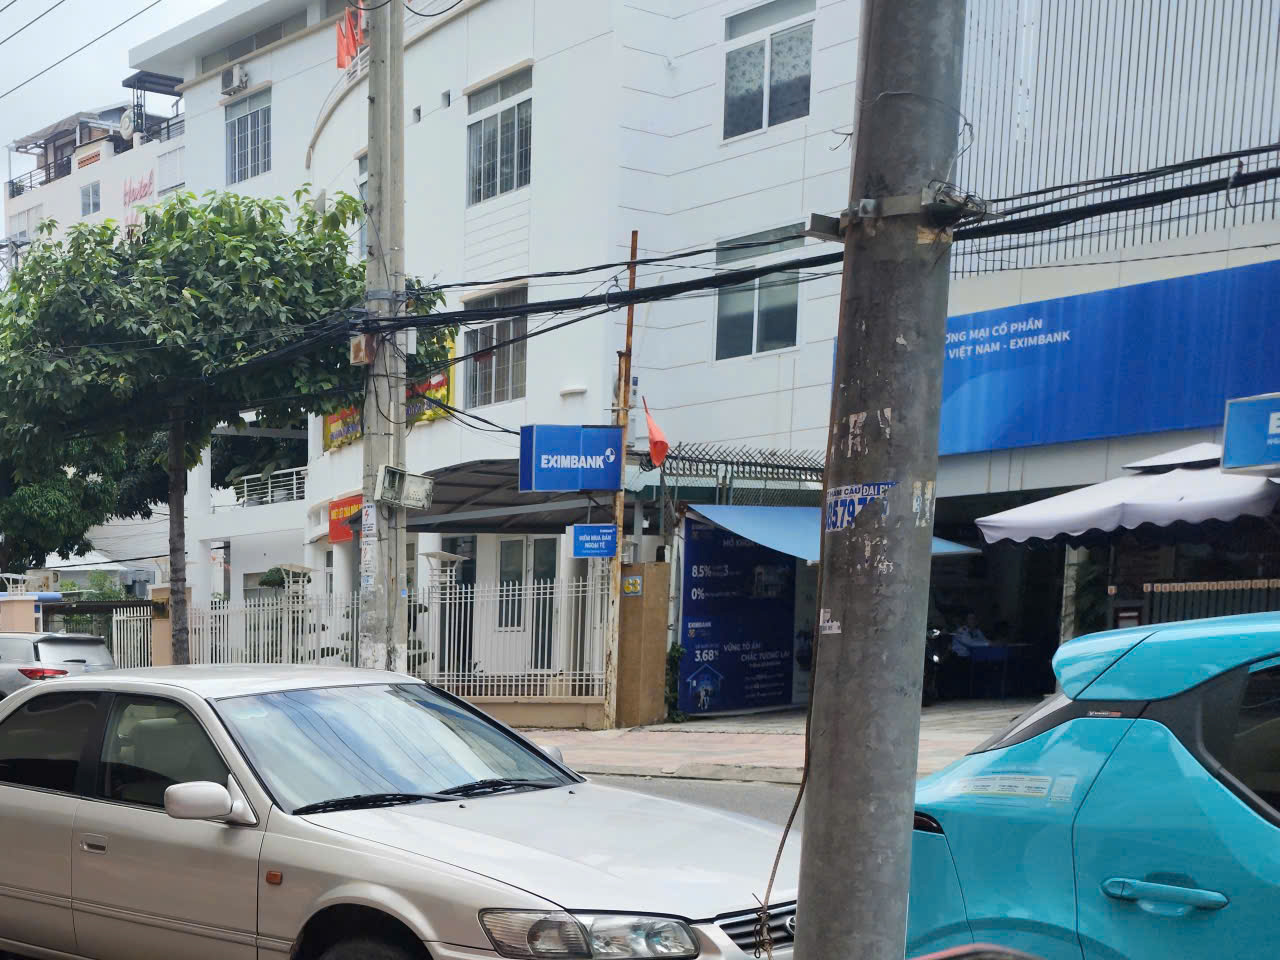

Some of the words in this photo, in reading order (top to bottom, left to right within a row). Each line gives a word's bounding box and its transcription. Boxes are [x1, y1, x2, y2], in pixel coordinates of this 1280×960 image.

[969, 327, 989, 341] MẠI
[992, 321, 1007, 336] CỔ
[1010, 317, 1043, 334] PHẦN
[949, 345, 972, 360] VIỆT
[975, 342, 1000, 355] NAM
[1009, 331, 1070, 350] EXIMBANK
[540, 454, 605, 469] EXIMBANK
